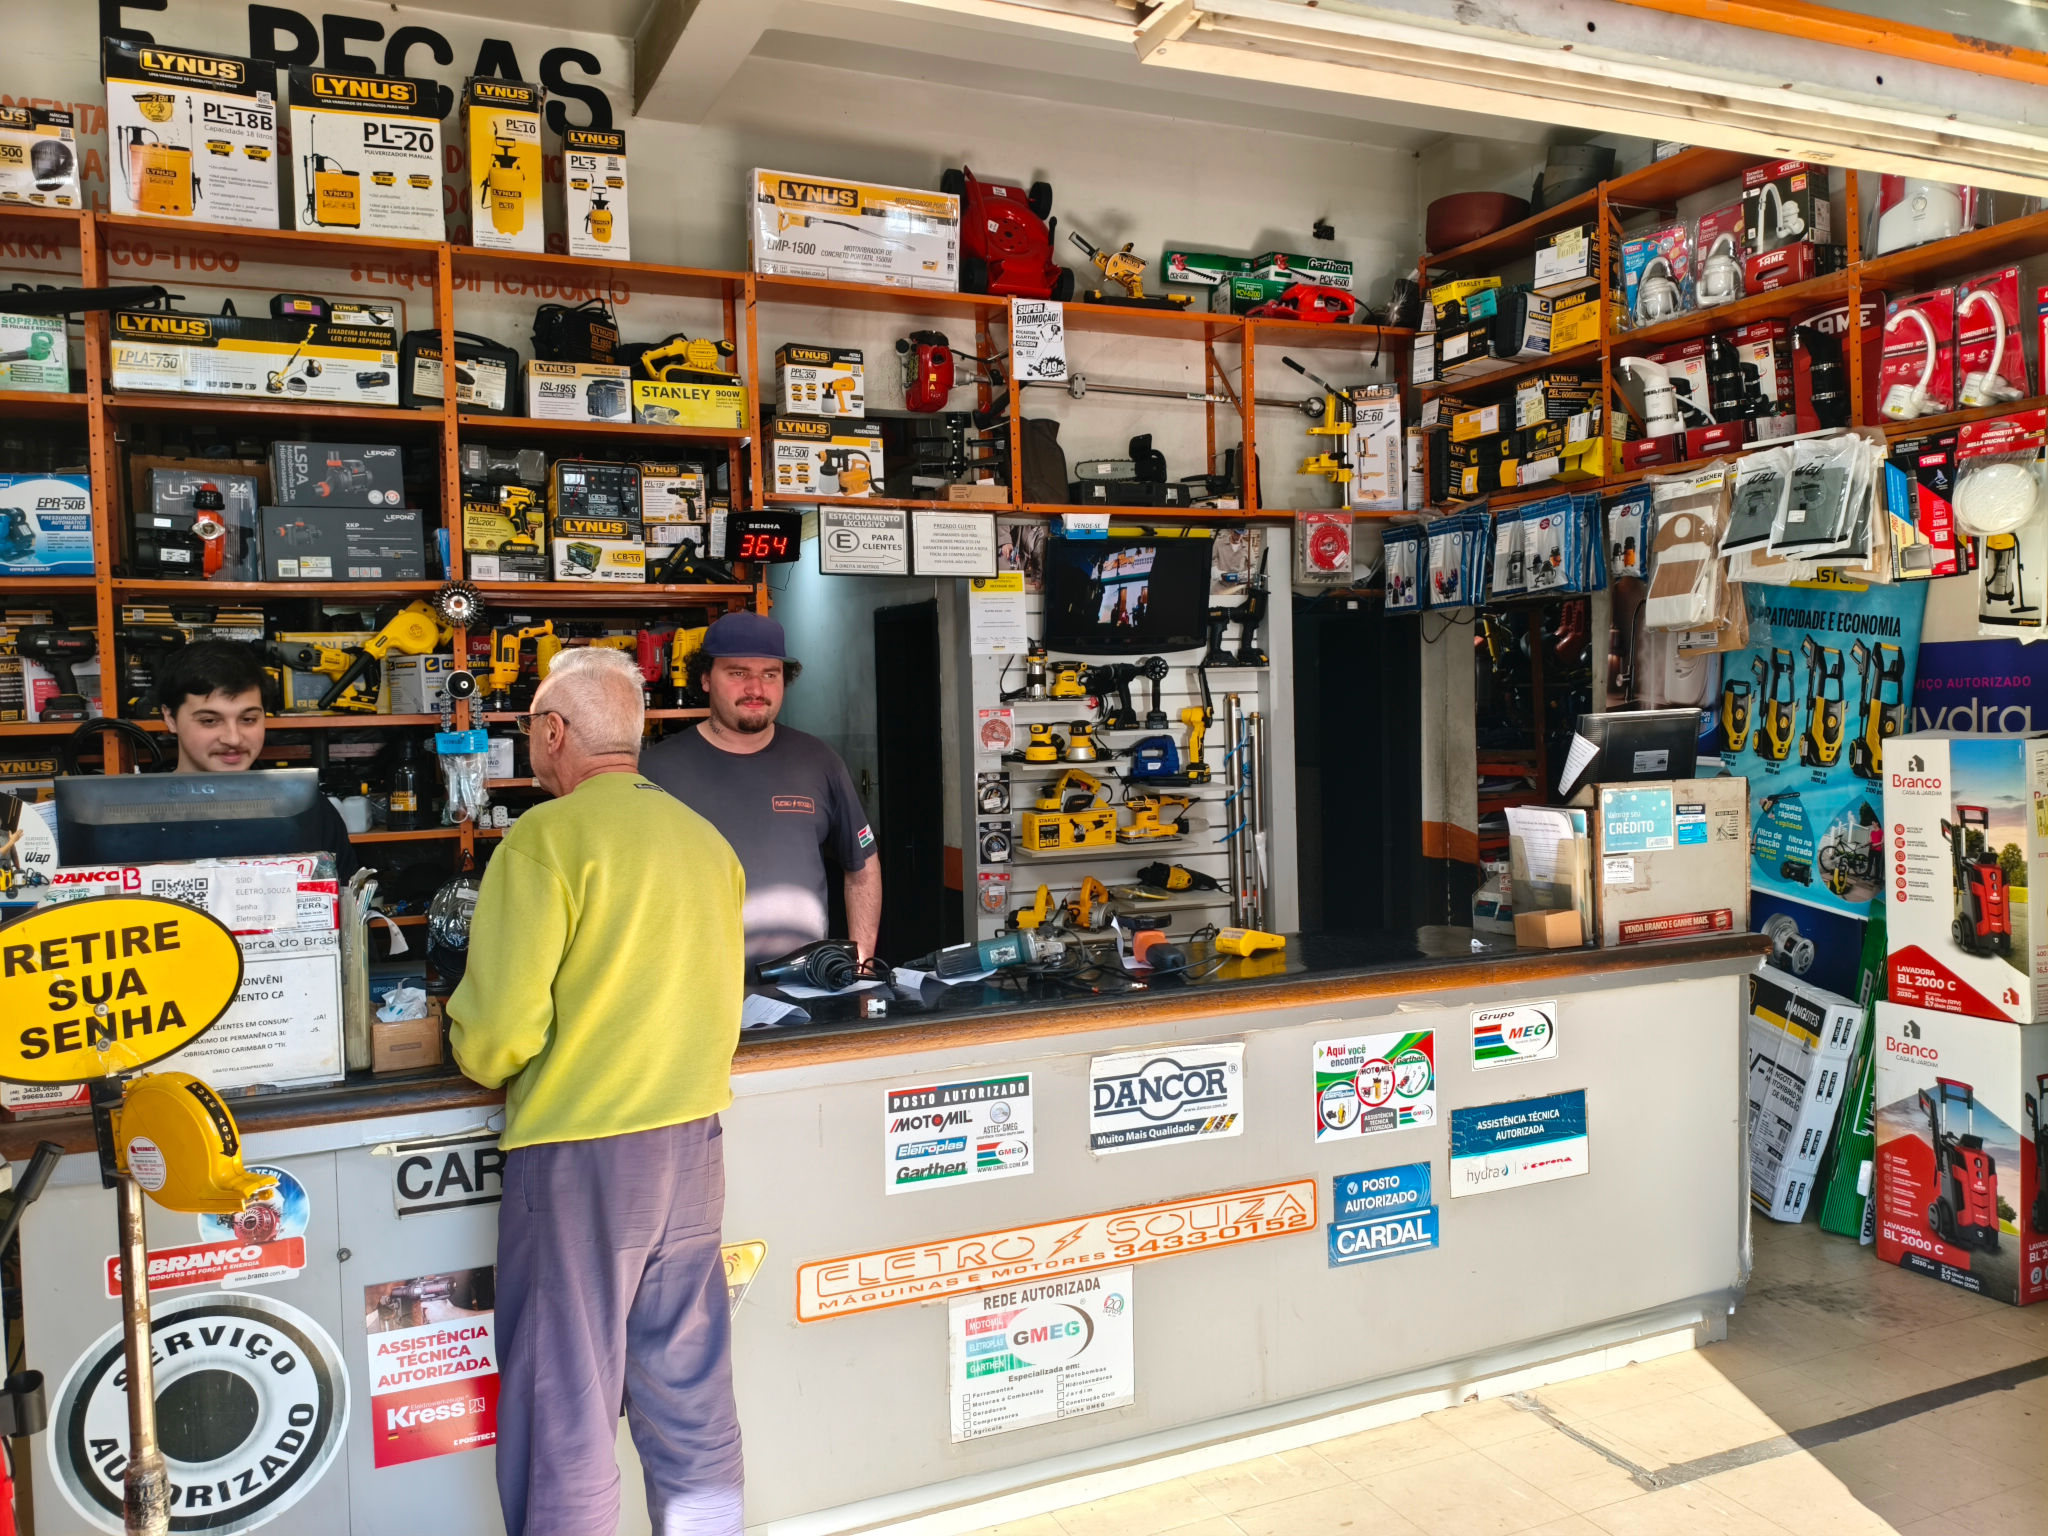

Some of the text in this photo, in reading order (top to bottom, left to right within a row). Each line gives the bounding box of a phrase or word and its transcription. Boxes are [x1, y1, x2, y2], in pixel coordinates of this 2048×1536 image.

[143, 52, 238, 79] LYNUS
[316, 76, 410, 101] LYNUS
[475, 84, 531, 101] LYNUS
[203, 102, 273, 131] PL-18B
[204, 124, 244, 136] Capacidade
[506, 119, 536, 134] PL-10
[363, 122, 434, 153] PL-20
[569, 131, 619, 146] LYNUS
[364, 149, 407, 158] PULVERIZADOR
[570, 155, 597, 171] PL-5
[145, 167, 176, 178] LYNUS
[323, 189, 353, 199] LYNUS
[493, 189, 522, 198] LYNUS
[780, 182, 855, 206] LYNUS
[767, 238, 816, 256] LMP-1500
[1308, 257, 1350, 273] Garthen
[1757, 252, 1787, 267] FAME
[1319, 274, 1350, 288] PCV-4500
[1456, 280, 1481, 289] STANLEY
[1017, 304, 1045, 314] SUPER
[1, 316, 63, 328] SOPRADOR
[120, 316, 208, 335] LYNUS
[1017, 311, 1059, 325] PROMOÇÃO!
[327, 327, 358, 336] LIXADEIRA
[330, 334, 342, 342] LED
[117, 350, 178, 369] LPLA-750
[791, 349, 829, 360] LYNUS
[533, 364, 576, 376] LYNUS
[790, 367, 816, 380] PPL-350
[1551, 375, 1579, 383] LYNUS
[539, 382, 576, 394] ISL-195S
[641, 385, 740, 402] STANLEY 900W
[1353, 388, 1393, 399] LYNUS
[1356, 409, 1384, 422] SF-60
[776, 421, 829, 435] LYNUS
[777, 445, 809, 459] PPL-500
[294, 445, 309, 486] LSPA
[1921, 455, 1944, 465] FAME
[644, 465, 679, 475] LYNUS
[230, 482, 248, 494] 24
[37, 497, 86, 510] EPR-50B
[828, 513, 900, 523] ESTACIONAMENTO
[843, 520, 886, 528] EXCLUSIVO
[564, 519, 625, 535] LYNUS
[748, 522, 781, 530] SENHA
[740, 534, 787, 557] 364
[836, 533, 895, 549] E PARA
[862, 543, 903, 551] CLIENTES
[611, 553, 641, 563] LCB-10
[1837, 611, 1901, 637] ECONOMIA
[1946, 676, 2032, 690] AUTORIZADO
[1892, 774, 1942, 789] Branco
[191, 784, 215, 795] LG
[1038, 816, 1061, 824] STANLEY
[1609, 818, 1655, 835] CRÉDITO
[24, 851, 50, 864] Wap
[1624, 922, 1645, 934] VENDA
[1645, 920, 1668, 931] BRANCO
[3, 920, 182, 978] RETIRE
[279, 936, 299, 948] do
[1897, 965, 1936, 976] LAVADORA
[1897, 974, 1945, 989] BL 2000
[47, 967, 148, 1013] SUA
[1479, 1011, 1515, 1021] Grupo
[1784, 1000, 1821, 1028] MANGOTES
[19, 1000, 187, 1061] SENHA
[213, 1022, 244, 1032] CLIENTES
[1508, 1023, 1546, 1040] MEG
[230, 1031, 277, 1043] PERMANÊNCIA
[231, 1043, 267, 1054] CARIMBAR
[1326, 1044, 1366, 1057] Aqui você
[1886, 1036, 1939, 1060] Branco
[1330, 1055, 1365, 1068] encontra
[893, 1082, 1026, 1110] POSTO AUTORIZADO
[1093, 1070, 1227, 1112] DANCOR
[1183, 1103, 1228, 1114] www.dancor.com.br
[890, 1109, 973, 1134] MOTOMIL
[1476, 1107, 1560, 1130] ASSISTÊNCIA TÉCNICA
[983, 1122, 1019, 1135] ASTEC-GMEG
[1097, 1123, 1195, 1146] Muito Mais Qualidade
[1495, 1124, 1545, 1140] AUTORIZADA
[897, 1137, 967, 1158] Eletroplas
[998, 1147, 1024, 1157] GMEG
[896, 1160, 967, 1182] Garthen
[977, 1160, 1029, 1174] WWW.GMEG.COM.BR
[1466, 1165, 1500, 1184] hydra
[396, 1151, 503, 1201] CAR
[1362, 1175, 1400, 1193] POSTO
[1344, 1190, 1418, 1213] AUTORIZADO
[1883, 1220, 1922, 1237] LAVADORA
[817, 1190, 1306, 1297] ELETRO SOUZA
[1337, 1219, 1432, 1256] CARDAL
[1883, 1229, 1932, 1251] BL 2000
[149, 1245, 262, 1273] BRANCO
[818, 1213, 1308, 1311] MÁQUINAS MOTORES 3433-0152
[186, 1260, 260, 1277] DE FORÇA ENERGIA
[234, 1269, 287, 1283] www.branco.com.br
[983, 1277, 1101, 1311] REDE AUTORIZADA
[969, 1317, 1004, 1331] MOTOMIL
[1013, 1320, 1081, 1346] GMEG
[377, 1325, 488, 1357] ASSISTÊNCIA
[112, 1325, 297, 1394] SERVIÇO
[395, 1343, 472, 1367] TÉCNICA
[377, 1356, 491, 1388] AUTORIZADA
[969, 1359, 1005, 1374] GARTHEN
[1008, 1365, 1064, 1383] Especializada
[1065, 1366, 1107, 1379] Motobombas
[972, 1386, 1014, 1399] Ferramentas
[386, 1401, 466, 1431] Kress
[972, 1406, 1007, 1417] Geradores
[1065, 1406, 1084, 1415] Linha
[89, 1401, 316, 1510] AUORIZADO
